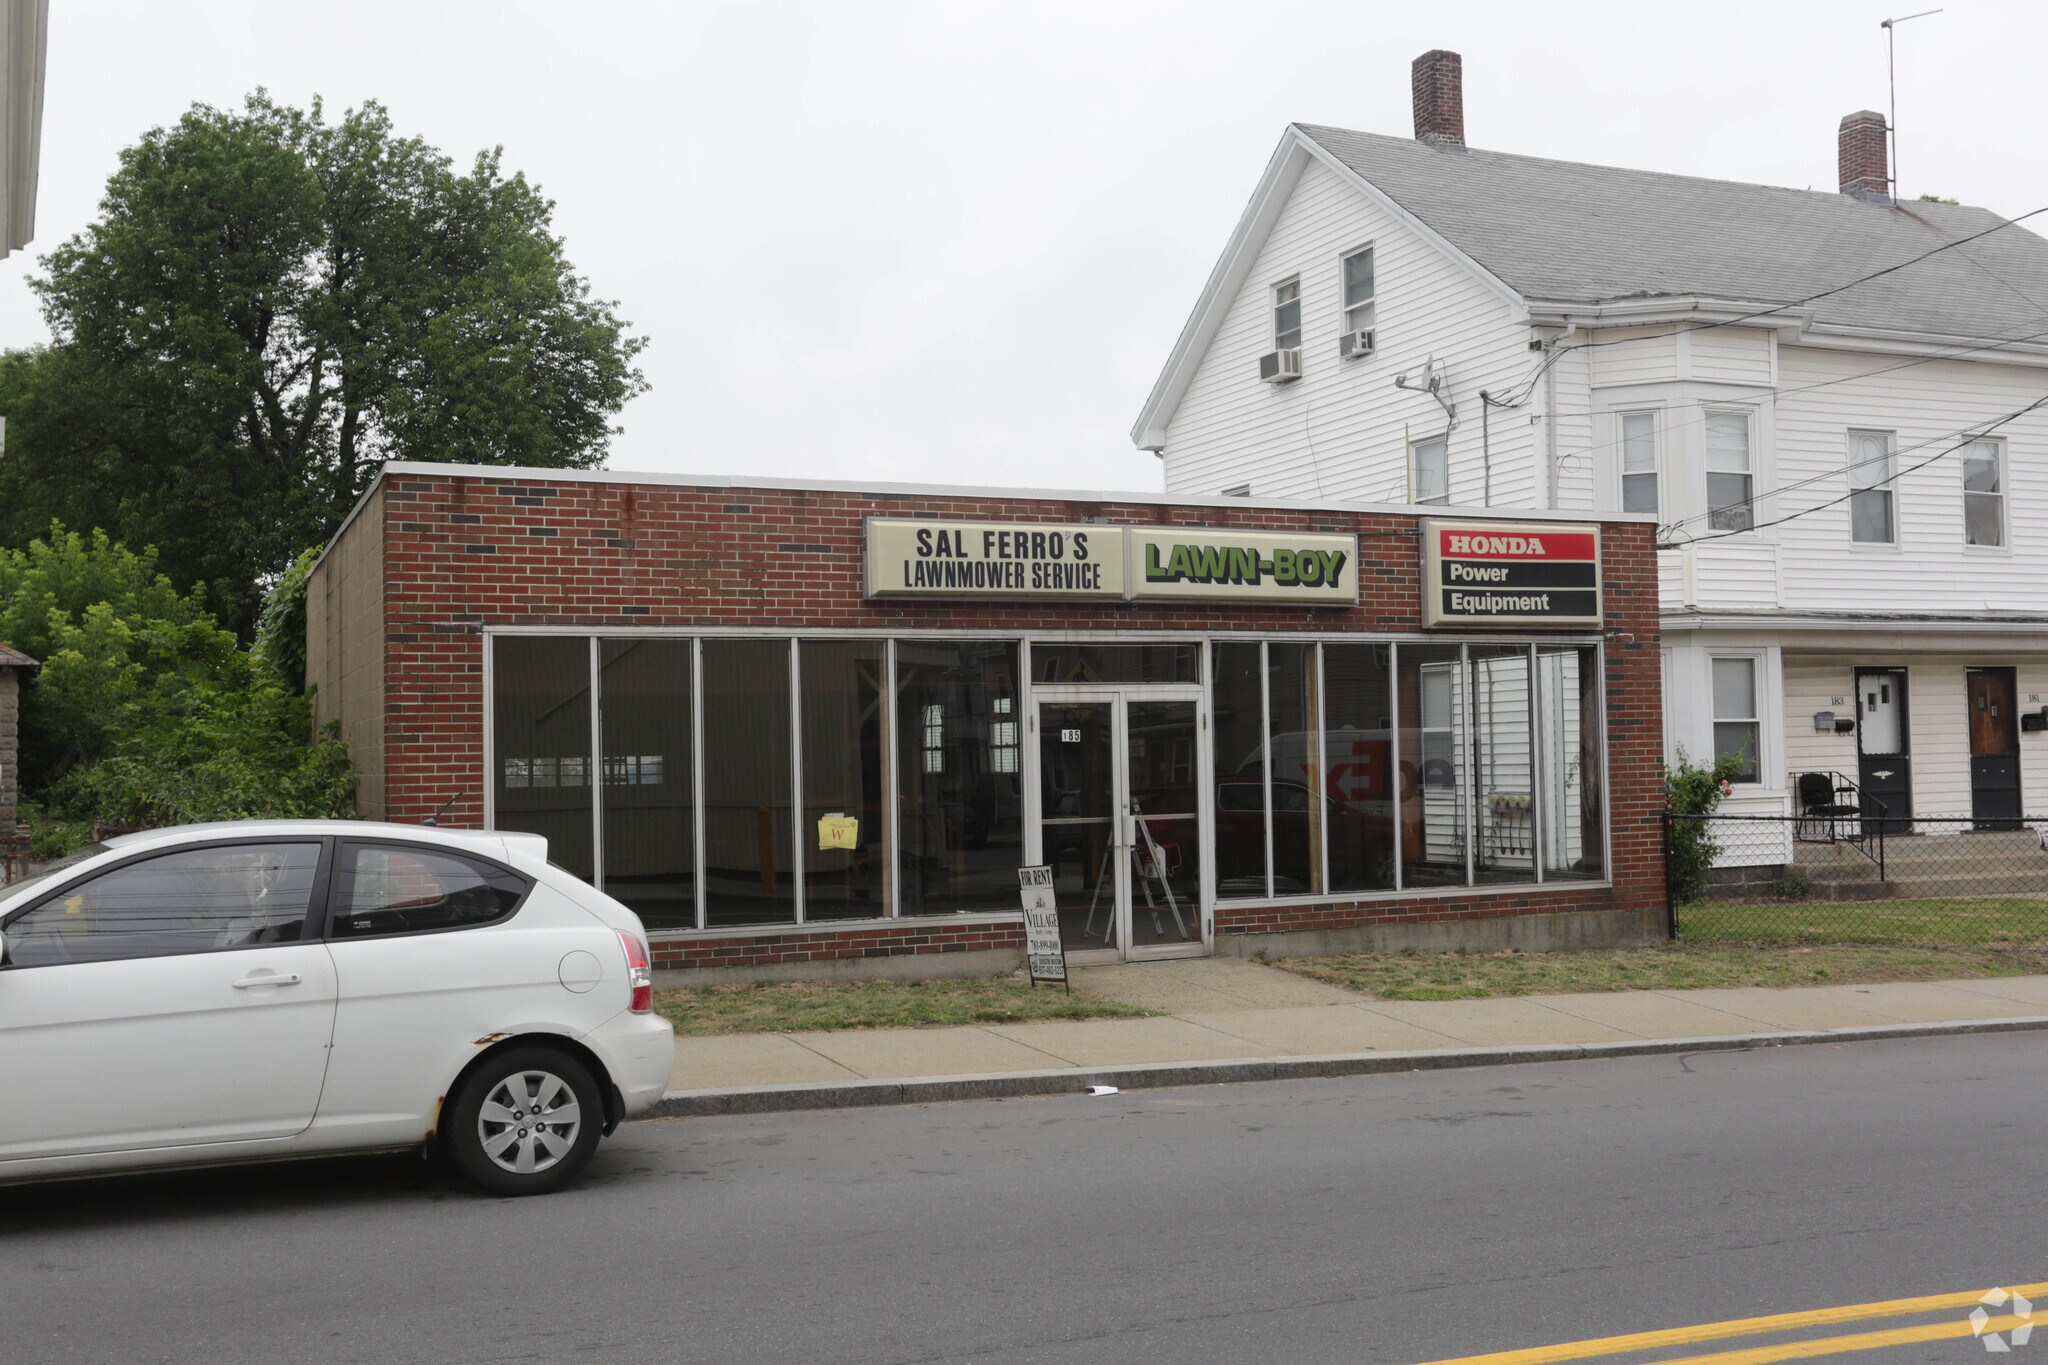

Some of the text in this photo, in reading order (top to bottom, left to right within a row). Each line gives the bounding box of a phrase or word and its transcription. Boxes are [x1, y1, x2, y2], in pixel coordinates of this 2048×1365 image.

[917, 528, 1089, 560] SAL FERRO'S
[1449, 535, 1545, 555] HONDA
[904, 560, 1101, 590] LAWNMOWER SERVICE
[1145, 543, 1347, 588] LAWN-BOY
[1450, 563, 1509, 582] Power
[1451, 592, 1550, 614] Equipment
[1831, 696, 1844, 706] 183
[2029, 694, 2040, 703] 181
[1063, 730, 1079, 741] 185
[831, 828, 845, 840] W
[1020, 869, 1051, 887] FOR RENT
